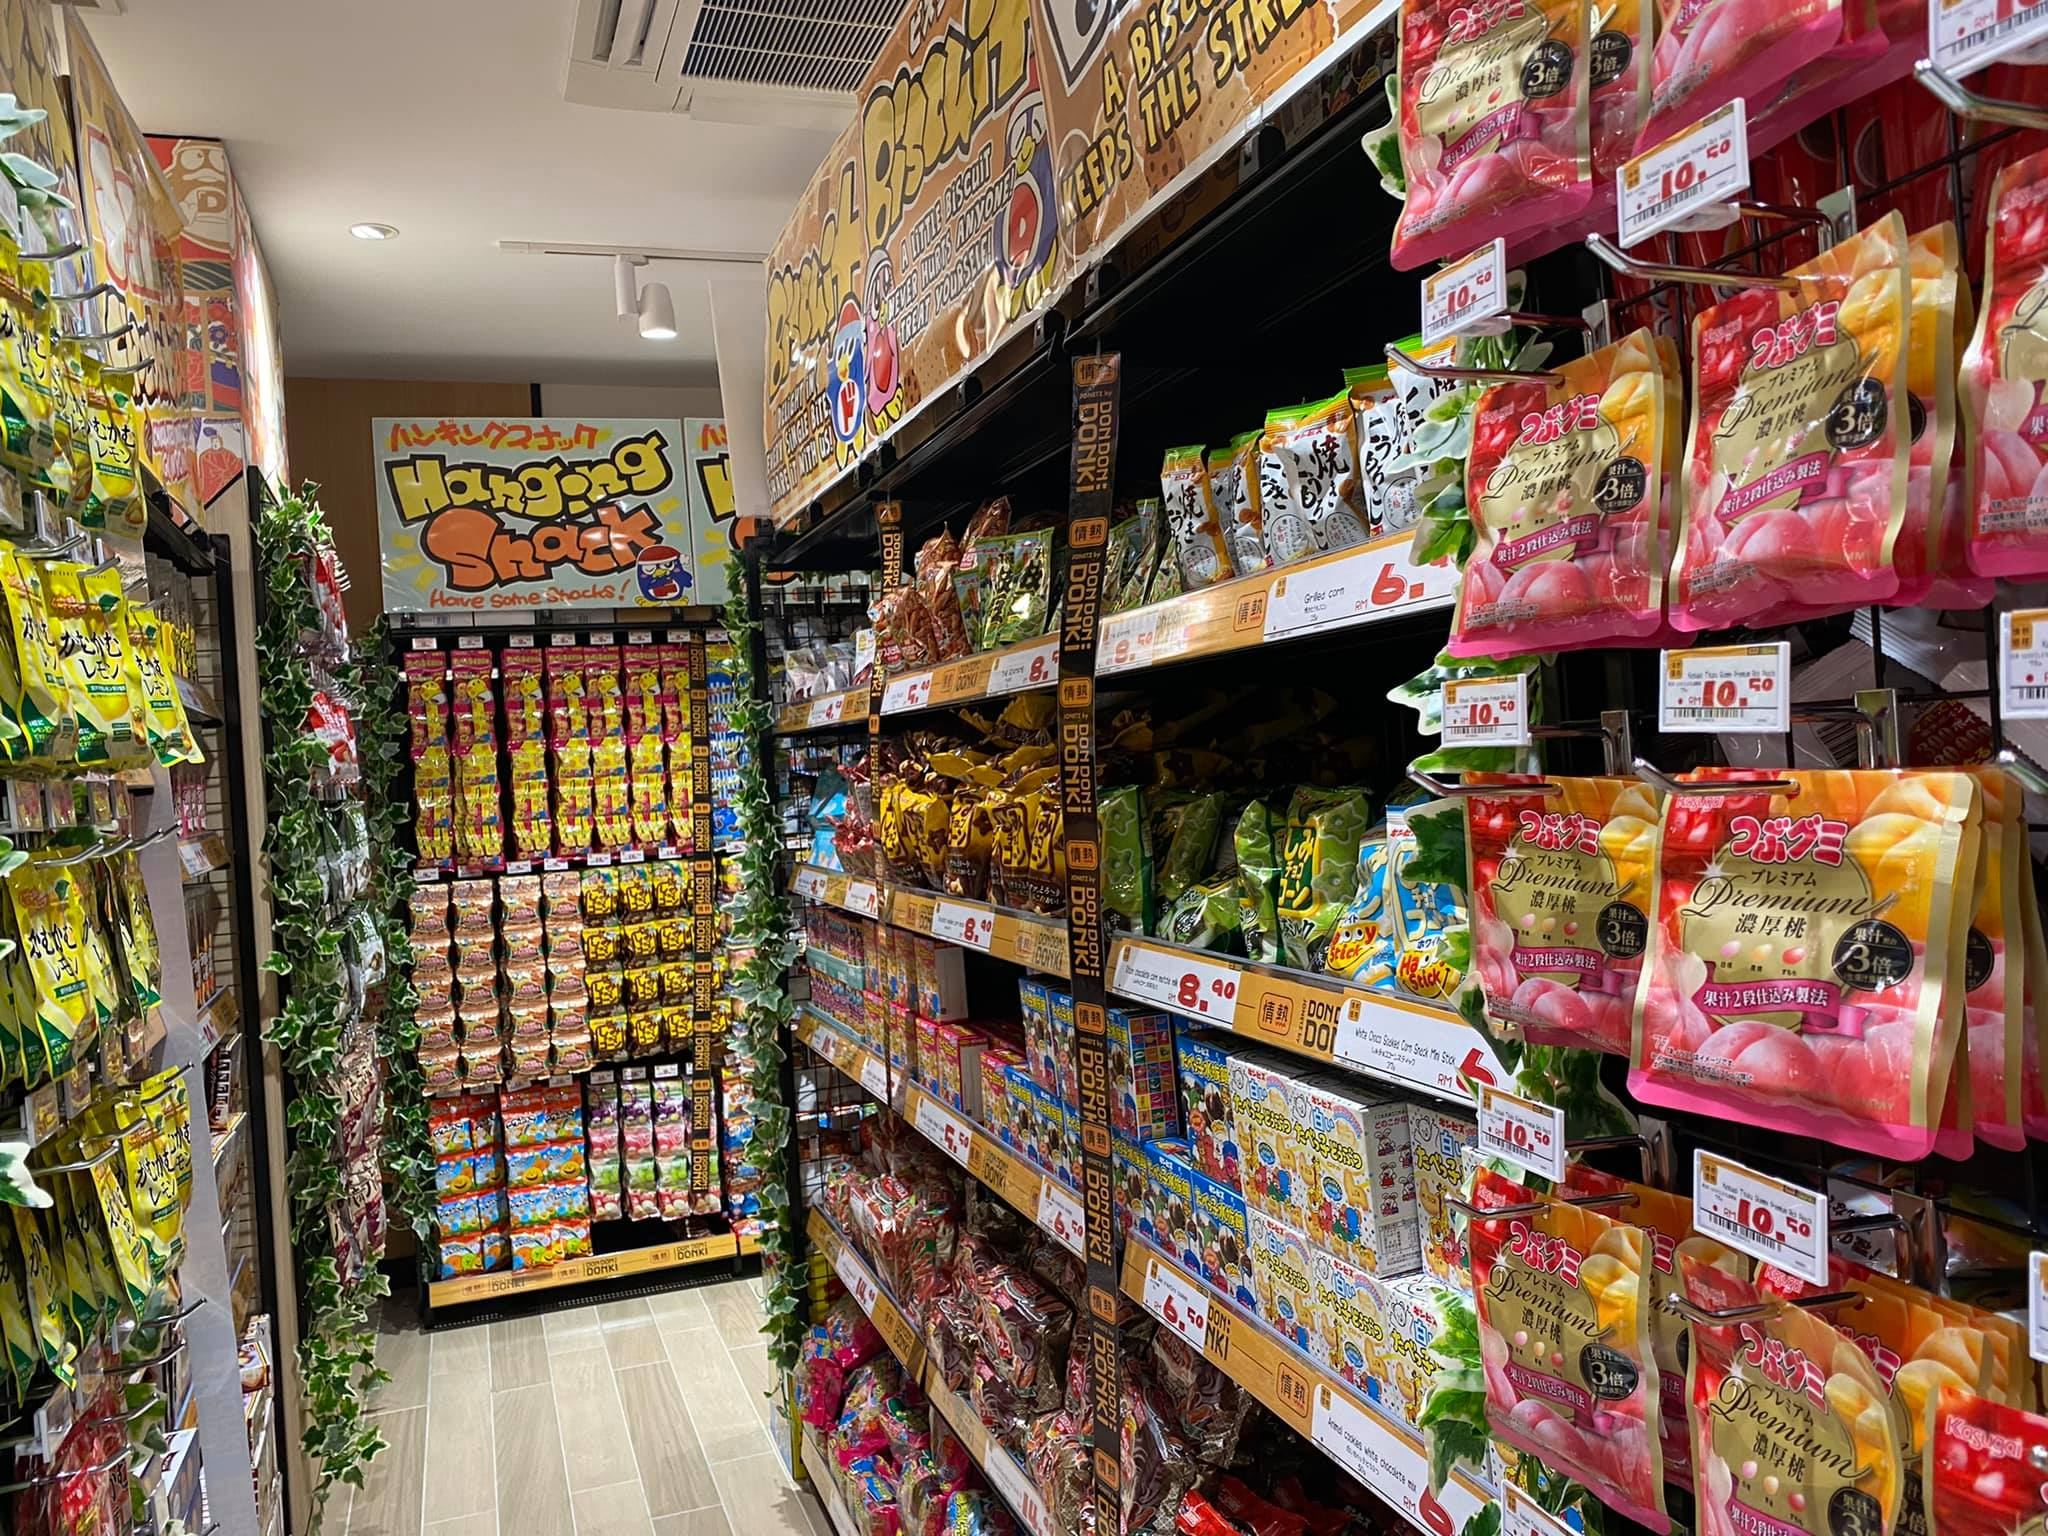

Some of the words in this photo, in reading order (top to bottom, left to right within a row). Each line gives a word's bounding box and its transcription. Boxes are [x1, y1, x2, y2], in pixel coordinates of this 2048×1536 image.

[1058, 113, 1133, 229] KEEPS
[1138, 43, 1201, 154] THE
[1661, 139, 1731, 200] 10.50
[887, 270, 918, 326] NEVER
[920, 228, 953, 292] HURTS
[955, 161, 1017, 252] ANYONE!
[899, 291, 931, 348] TREAT
[935, 226, 994, 316] YOURSELF!
[1750, 299, 1841, 372] つぶグミ
[1711, 355, 1872, 439] Premium
[389, 418, 599, 453] ハンギングスナック
[1098, 401, 1113, 440] DON
[1520, 393, 1600, 447] つぶグミ
[1755, 411, 1806, 442] 濃厚桃
[97, 440, 132, 465] レモン
[1076, 402, 1099, 493] DONKI
[1481, 428, 1634, 502] Premium
[1533, 438, 1580, 463] プレミアム
[384, 428, 673, 528] Hanging
[1520, 472, 1572, 502] 濃厚桃
[1720, 458, 1822, 518] 果汁2段仕込み製法
[419, 503, 667, 592] Snack
[1498, 520, 1593, 563] 果汁2段仕込み製法
[430, 587, 486, 609] Have
[1086, 562, 1100, 601] DON
[1304, 590, 1325, 604] Grilled
[1064, 564, 1087, 652] DONKI
[59, 630, 122, 659] かむかむ
[80, 659, 120, 681] レモン
[1702, 678, 1774, 708] 10.50
[1469, 700, 1515, 726] 10.50
[1078, 724, 1090, 763] DON
[1063, 724, 1083, 814] DONKI
[1519, 809, 1602, 857] つぶグミ
[1730, 813, 1850, 868] つぶグミ
[1492, 855, 1632, 899] Premium
[1536, 853, 1583, 873] プレミアム
[1751, 868, 1817, 888] プレミアム
[1086, 887, 1097, 927] DON
[1277, 878, 1312, 910] コーン
[1529, 889, 1577, 915] 濃厚桃
[1681, 872, 1897, 919] Premium
[28, 923, 78, 960] かむかむ
[1072, 886, 1089, 977] DONKI
[1606, 920, 1638, 948] 3倍
[1735, 913, 1807, 940] 濃厚桃
[1853, 926, 1882, 944] 果汁
[46, 955, 79, 982] レモン
[1329, 944, 1361, 962] Stick
[1514, 948, 1598, 971] 果汁2段仕込み製法
[1848, 944, 1895, 979] 3倍
[1178, 973, 1236, 1013] 8.90
[1408, 969, 1441, 990] Stick
[1703, 986, 1829, 1009] 果汁2段仕込み製法
[1308, 999, 1334, 1023] DON
[1094, 1053, 1105, 1091] DON
[1437, 1073, 1453, 1088] RM
[1312, 1106, 1335, 1133] 白い
[1504, 1119, 1551, 1152] 10.50
[1293, 1121, 1363, 1170] たべっ子どうぶつ
[147, 1178, 179, 1208] レモン
[1100, 1173, 1110, 1214] DON
[1086, 1167, 1102, 1262] DONKI
[1737, 1198, 1811, 1243] 10.50
[586, 1264, 618, 1278] DONKI
[677, 1247, 709, 1261] DONKI
[1509, 1221, 1584, 1290] つぶグミ
[1333, 1270, 1356, 1299] 白い
[1484, 1264, 1613, 1340] Premium
[1163, 1294, 1204, 1332] 6.50
[1316, 1281, 1384, 1342] たべっ子どうぶつ
[1520, 1308, 1561, 1345] 濃厚桃
[1094, 1331, 1109, 1426] DONKI
[1106, 1340, 1116, 1380] DON
[1740, 1322, 1830, 1416] つぶグミ
[1709, 1375, 1873, 1480] Premium
[1944, 1414, 2023, 1461] Kasugai
[1380, 1459, 1406, 1485] chocolate
[1753, 1430, 1805, 1483] 濃厚桃
[1403, 1495, 1417, 1514] RM
